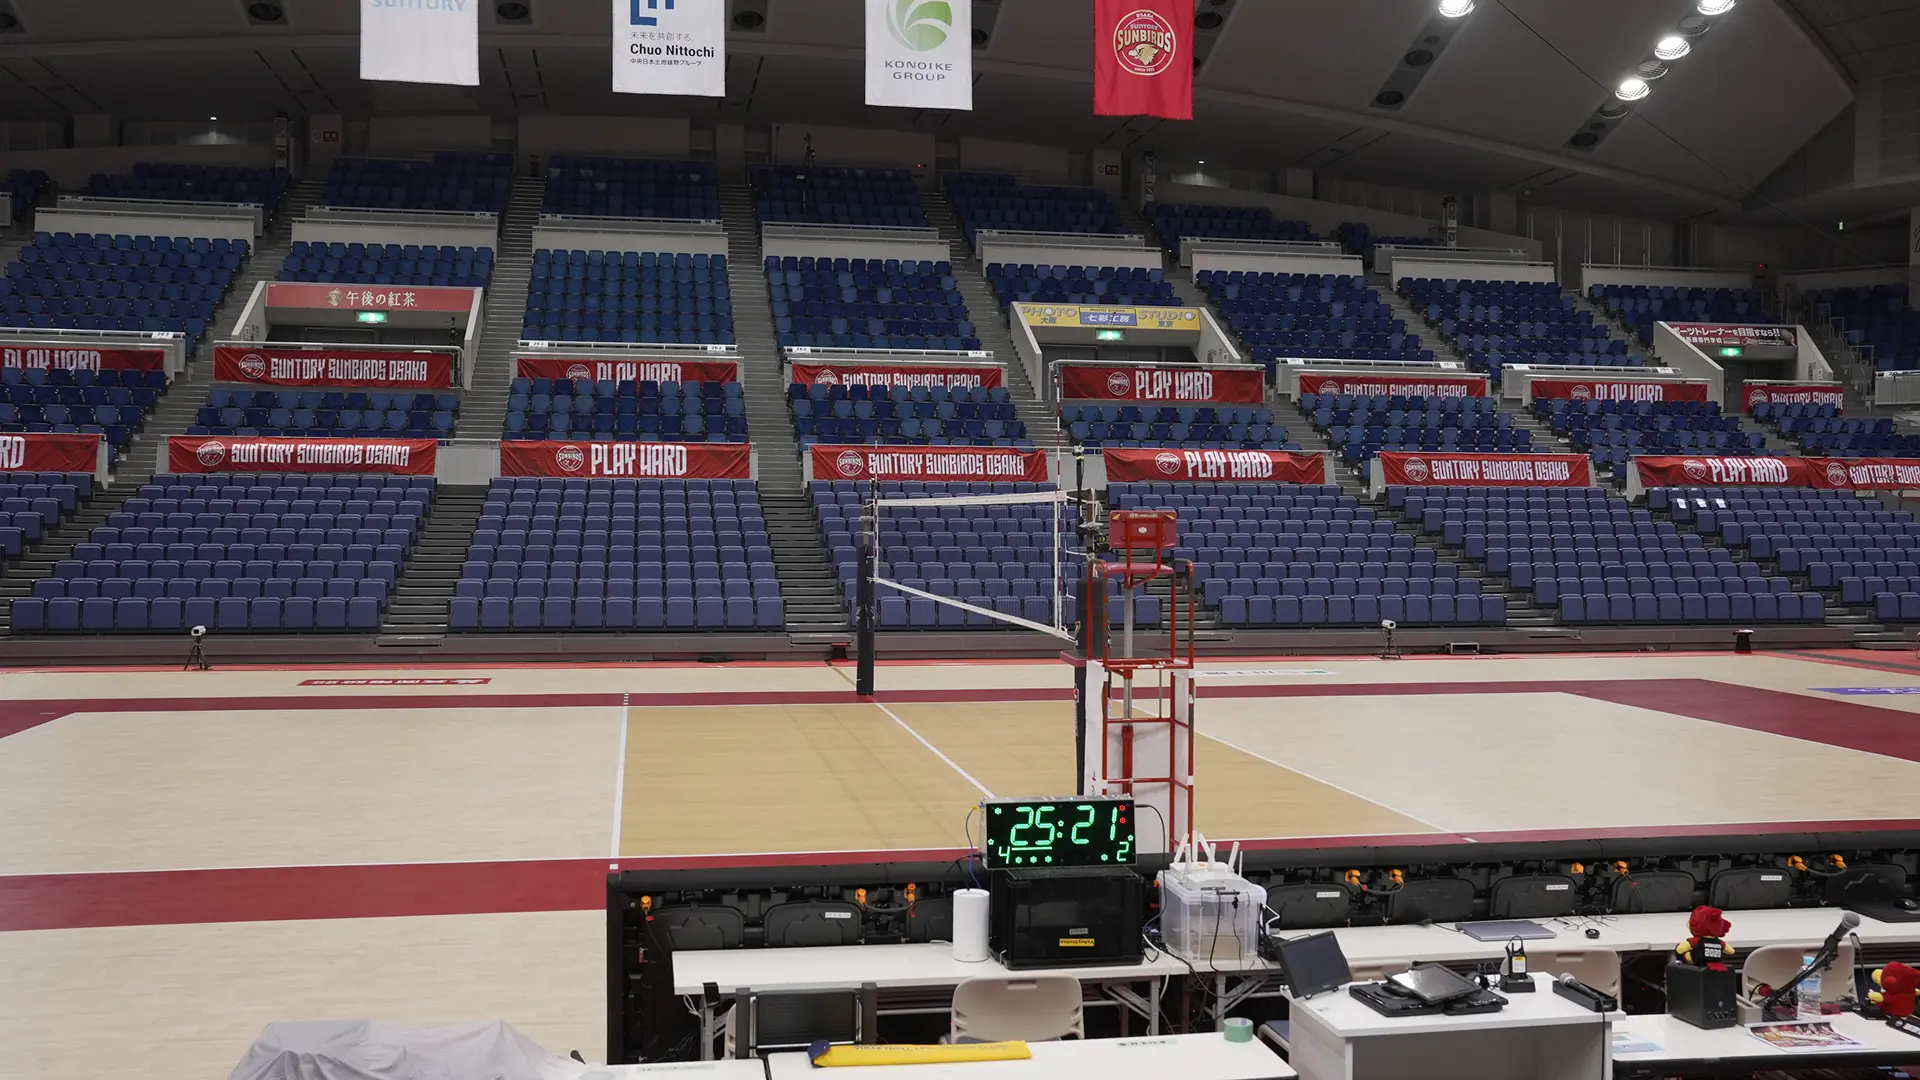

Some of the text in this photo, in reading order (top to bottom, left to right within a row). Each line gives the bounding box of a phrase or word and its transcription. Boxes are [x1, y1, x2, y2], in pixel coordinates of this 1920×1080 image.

[630, 43, 715, 58] Chuo Nittochi
[1117, 29, 1171, 53] SUNBIRDS
[630, 58, 702, 67] 中央日本土地建物グループ
[884, 60, 953, 71] KONOIKE
[892, 72, 945, 81] GROUP
[346, 291, 416, 307] 午後の紅茶
[1022, 306, 1077, 317] PHOTO
[1088, 314, 1130, 323] 七彩工房
[1138, 310, 1195, 321] STUDIO
[271, 358, 427, 381] SUNTORY SUNBIRDS OSAKA
[1135, 371, 1213, 399] PLAY HARD
[231, 443, 294, 463] SUNTORY
[297, 445, 362, 464] SUNBIRDS
[366, 445, 410, 467] OSAKA
[591, 443, 687, 476] PLAY HARD
[868, 453, 1025, 476] SUNTORY SUNBIRDS OSAKA
[1184, 451, 1272, 478] PLAY HARD
[1431, 460, 1570, 481] SUNTORY SUNBIRDS OSAKA
[1705, 457, 1747, 482] PLAY
[1747, 458, 1789, 483] HARD
[1849, 464, 1895, 484] SUNTORY
[998, 846, 1010, 864] 4
[1117, 841, 1129, 861] 2
